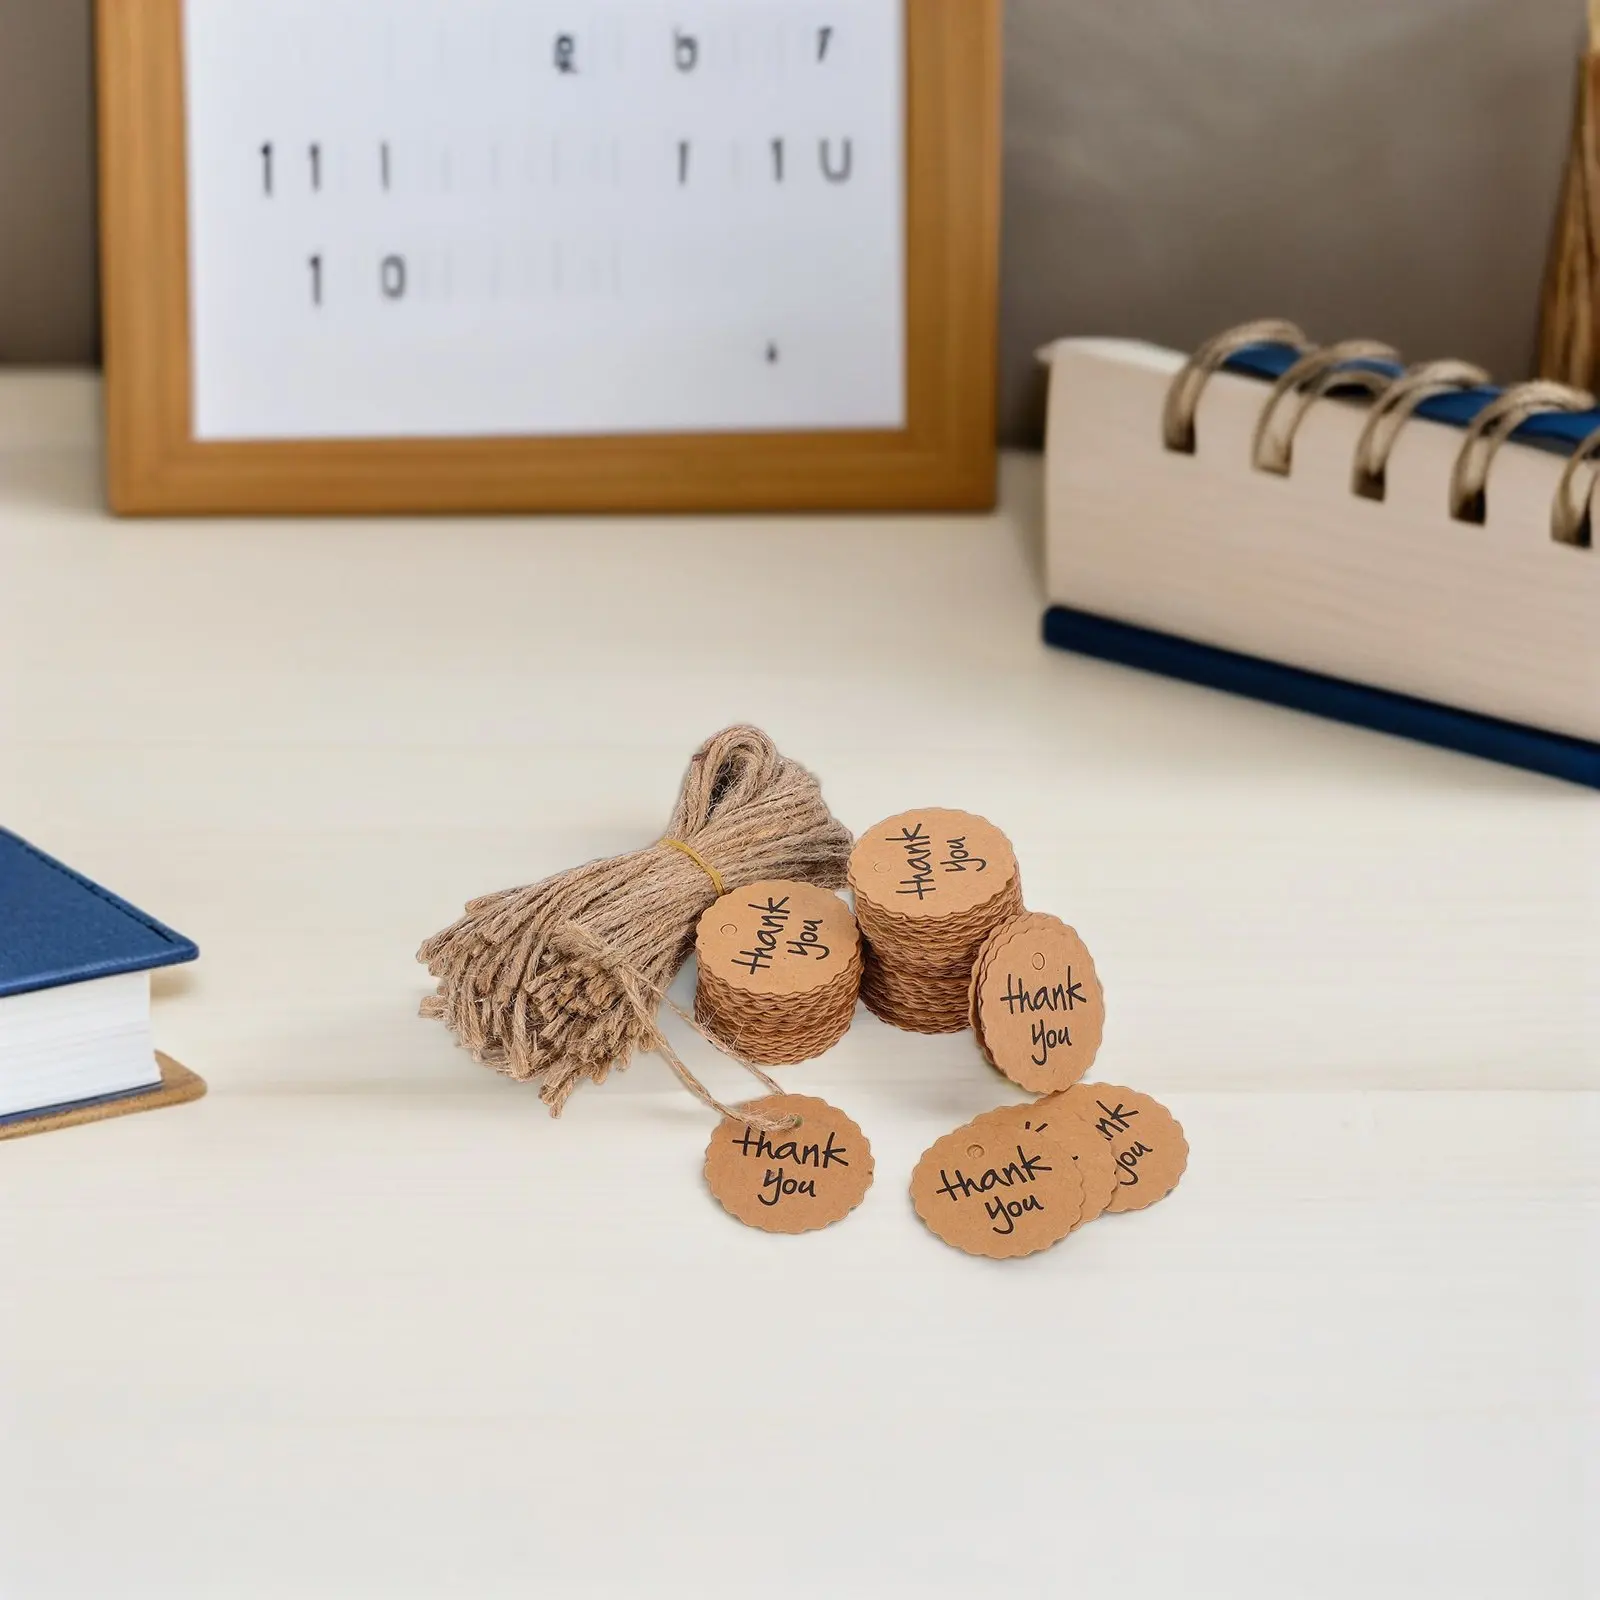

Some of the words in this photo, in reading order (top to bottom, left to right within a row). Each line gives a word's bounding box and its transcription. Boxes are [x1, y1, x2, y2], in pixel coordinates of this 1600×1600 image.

[885, 822, 938, 900] thank
[939, 835, 988, 873] you
[731, 895, 791, 975] thank
[787, 917, 831, 961] you
[1000, 965, 1087, 1015] thank
[1030, 1018, 1073, 1067] you
[731, 1126, 850, 1170] thank
[757, 1169, 817, 1206] you
[935, 1144, 1053, 1203] thank
[984, 1194, 1045, 1235] you
